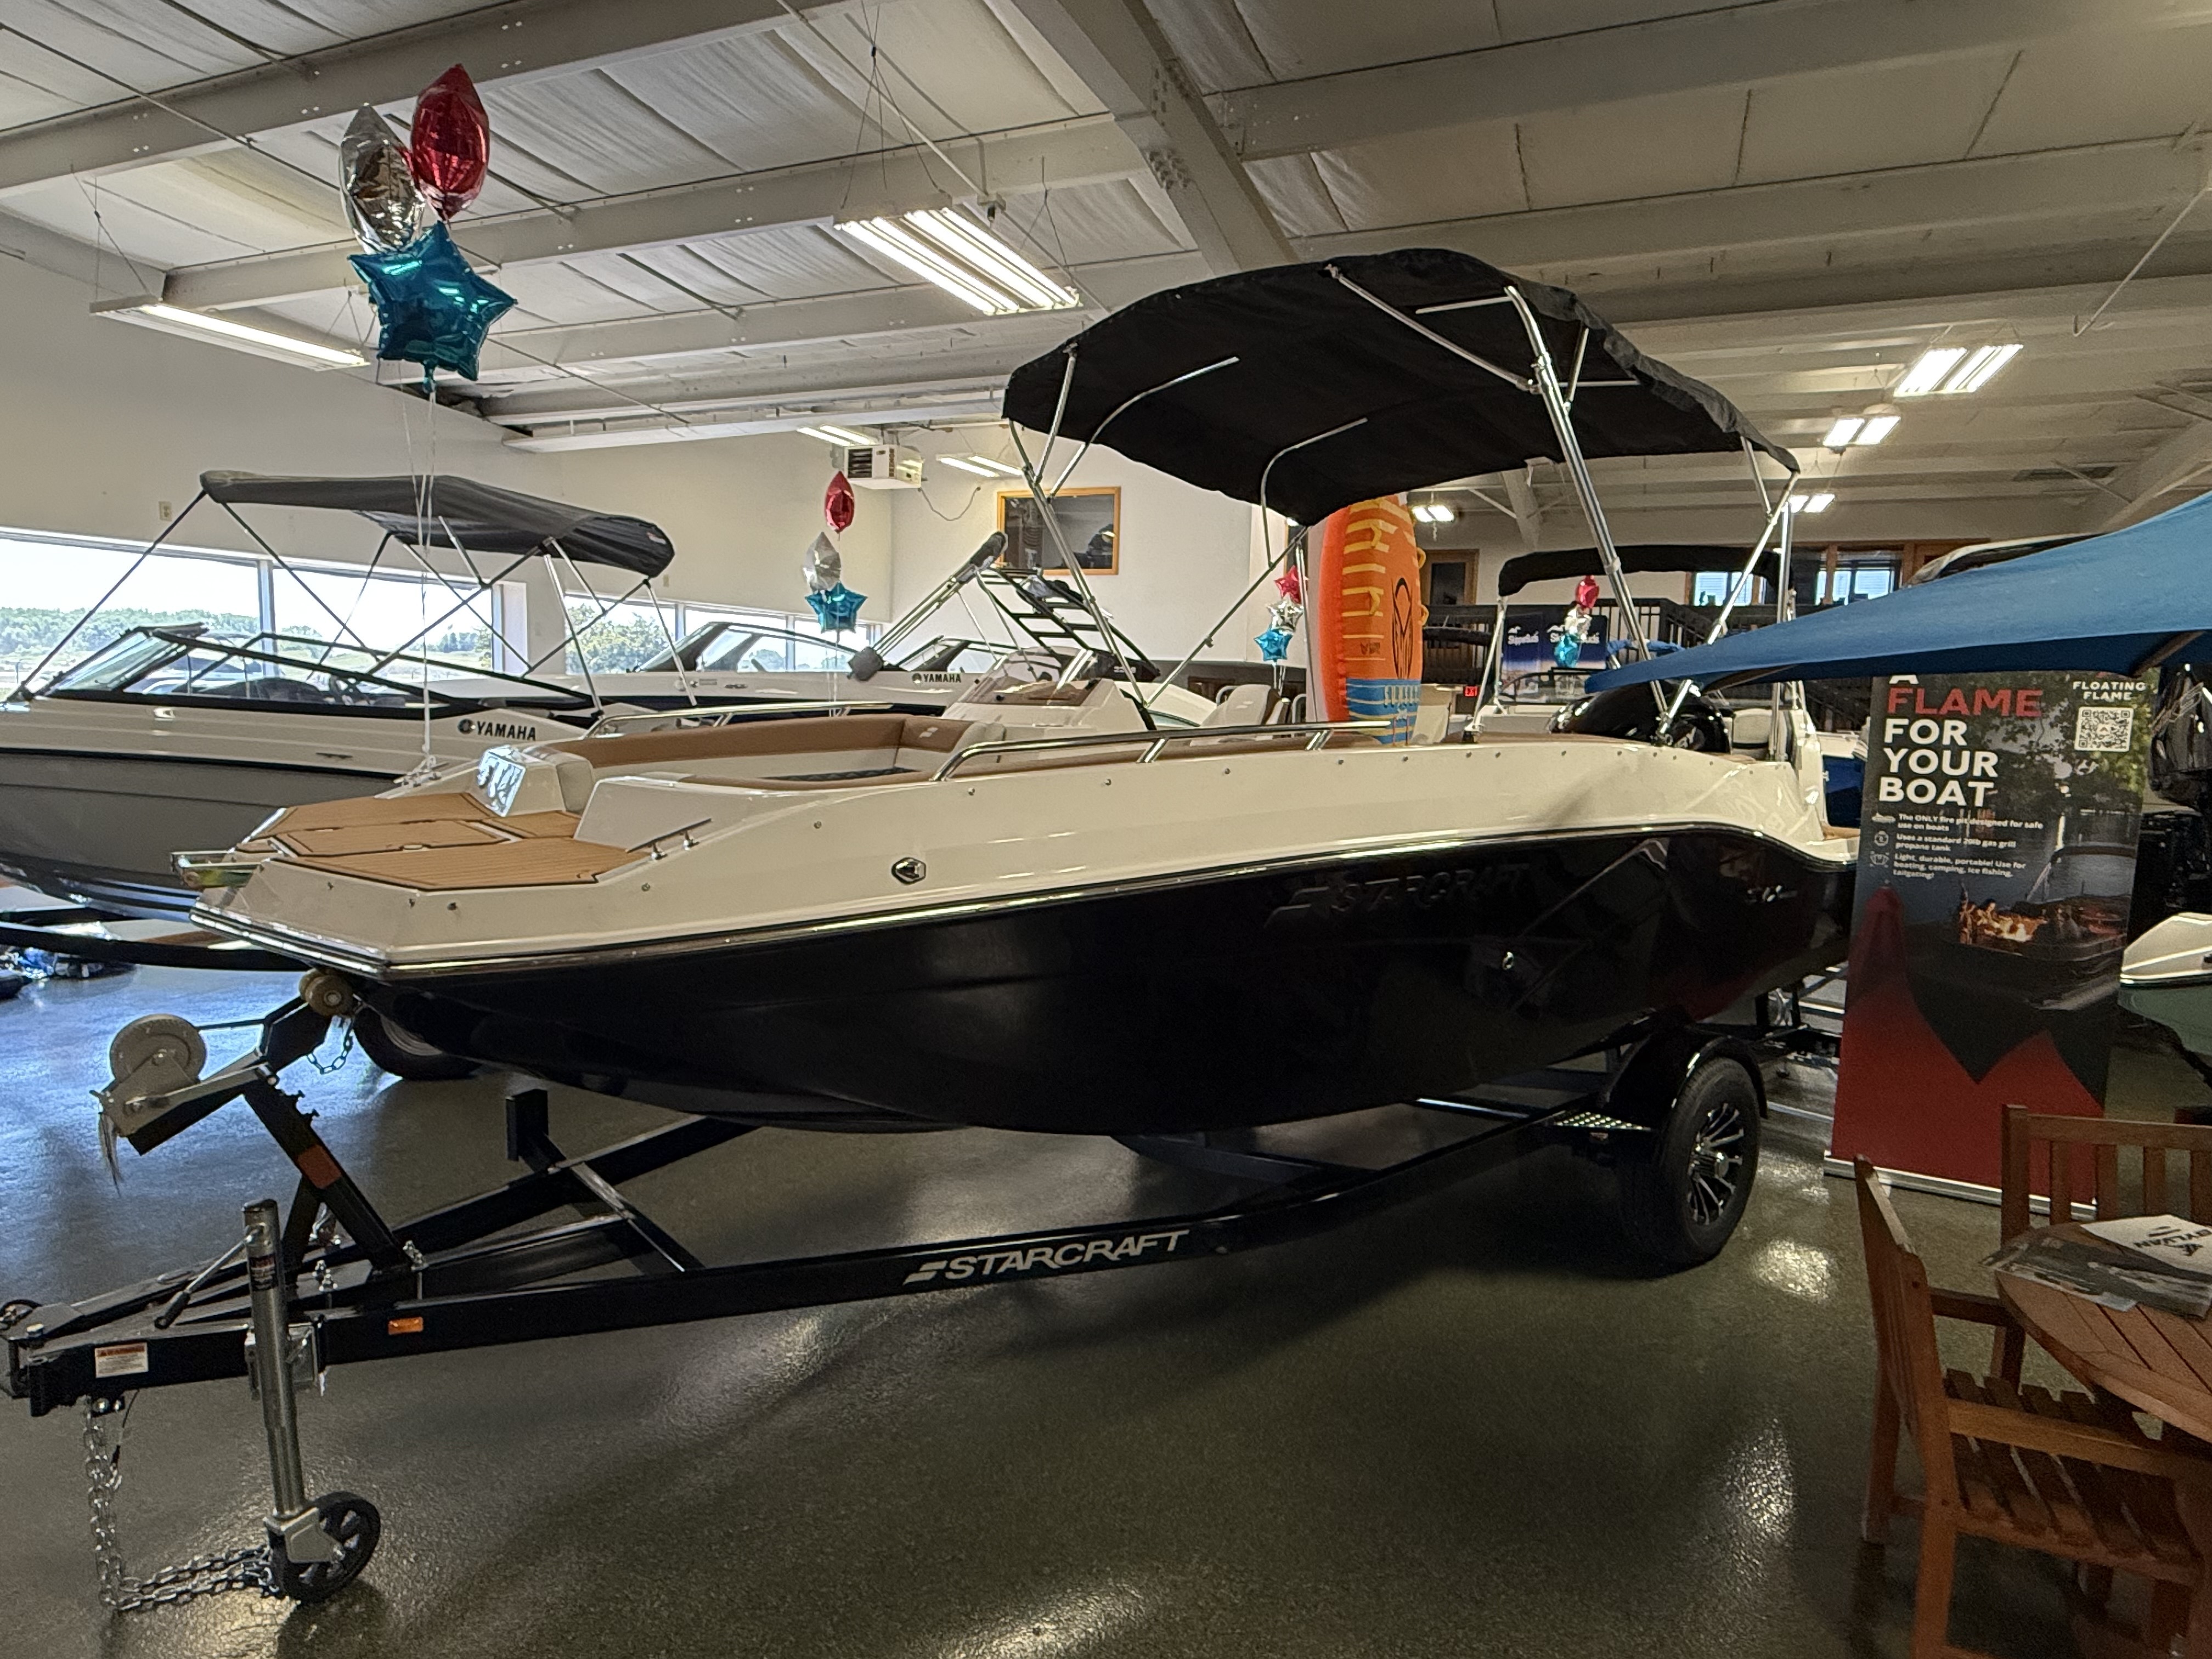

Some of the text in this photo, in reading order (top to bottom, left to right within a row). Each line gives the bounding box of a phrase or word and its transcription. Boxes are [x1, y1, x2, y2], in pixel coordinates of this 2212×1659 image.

[923, 674, 961, 683] YAMAHA
[2073, 681, 2146, 691] FLOATING
[1888, 688, 2042, 718] FLAME
[2083, 691, 2132, 701] FLAME
[476, 720, 536, 741] YAMAHA
[1884, 719, 1967, 746] FOR
[1882, 748, 1999, 777] YOUR
[1878, 777, 1994, 807] BOAT
[1898, 813, 1913, 821] The
[1969, 818, 2008, 827] designed
[1924, 836, 1962, 844] standard
[1998, 840, 2016, 849] grill
[945, 1229, 1190, 1280] STARCRAFT
